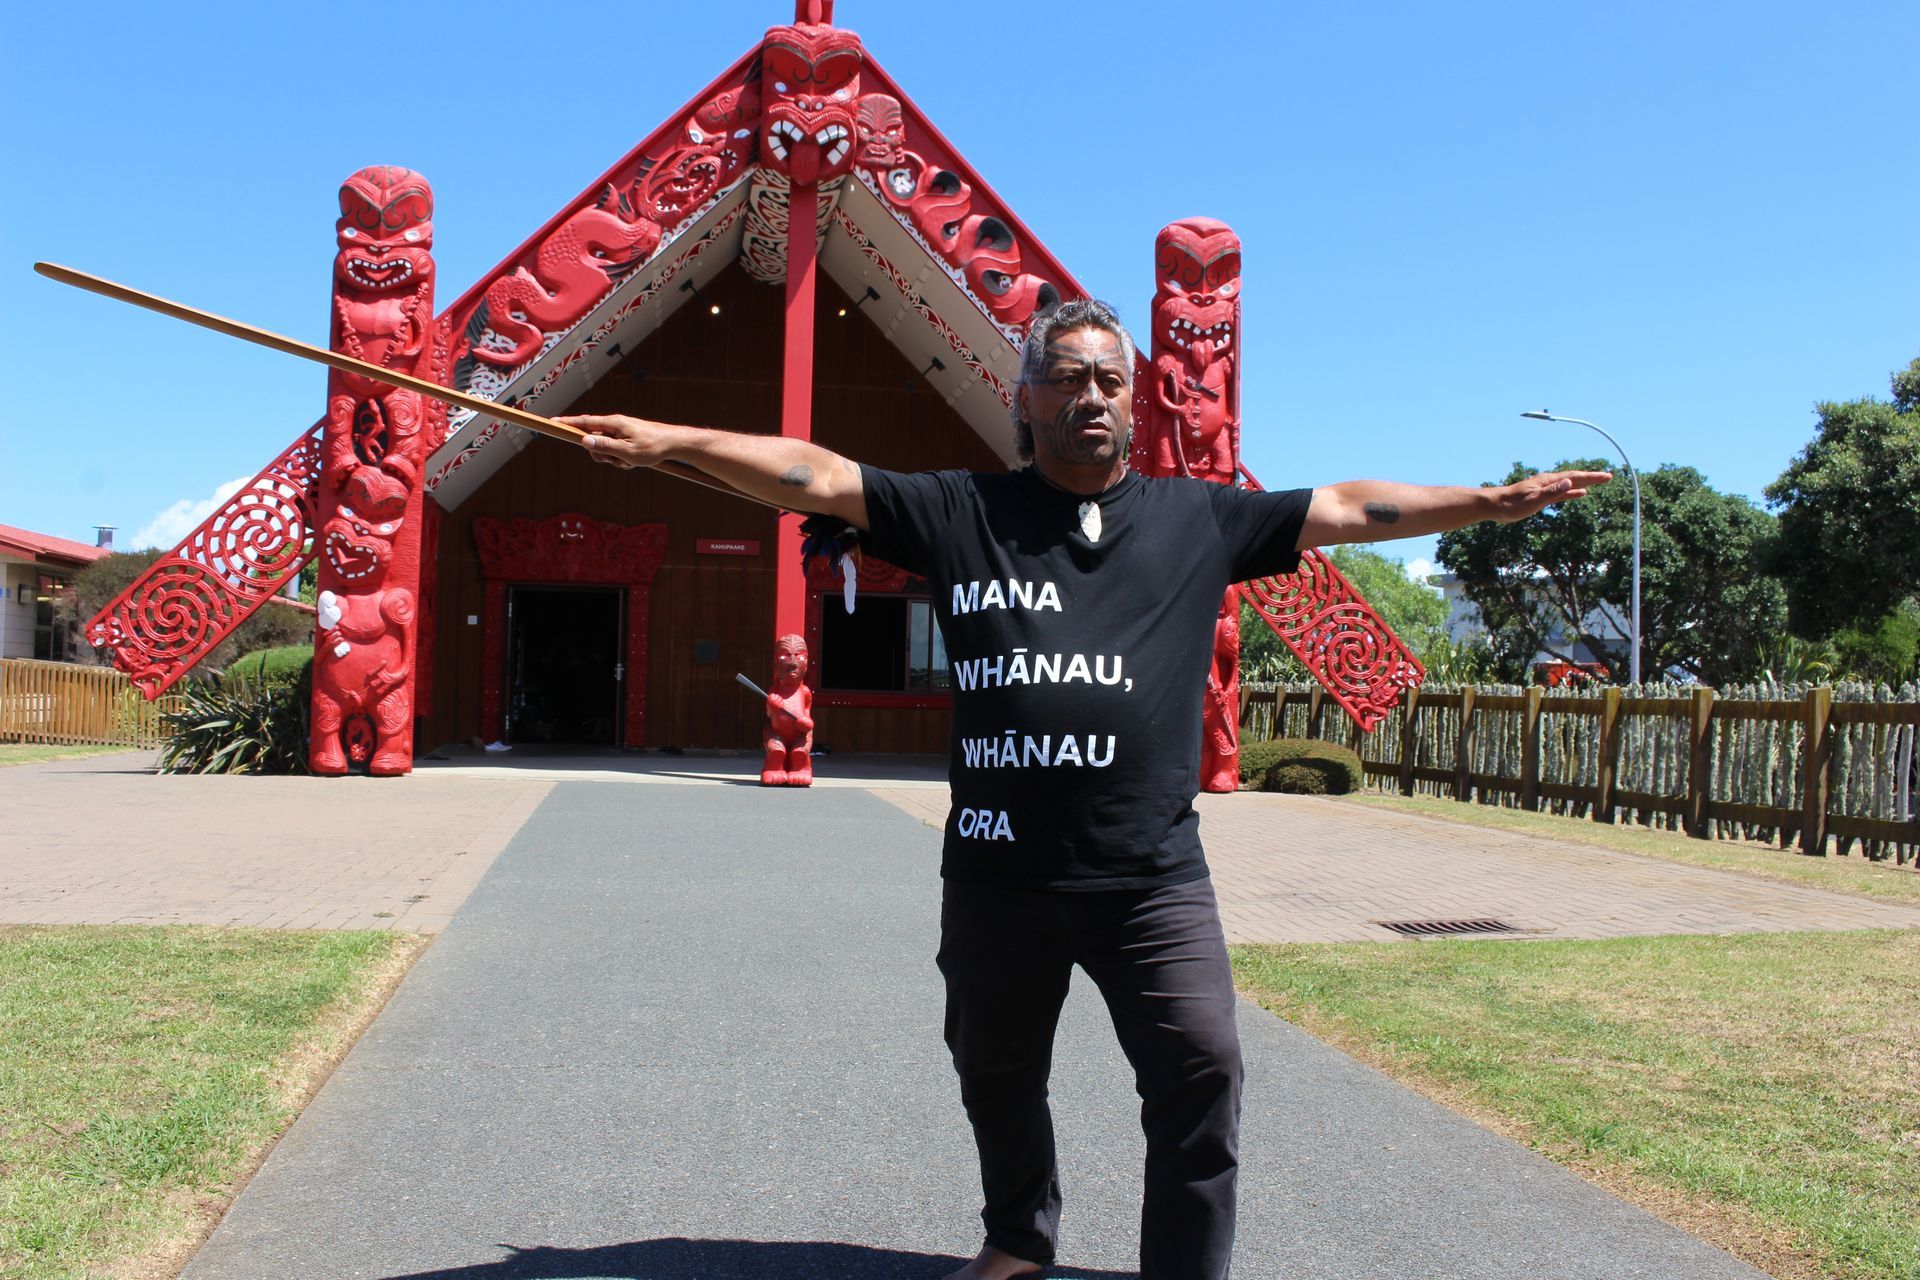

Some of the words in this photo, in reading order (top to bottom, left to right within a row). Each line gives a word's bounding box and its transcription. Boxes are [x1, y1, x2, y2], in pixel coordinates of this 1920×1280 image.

[952, 577, 1063, 616] MANA
[953, 647, 1134, 692] WHĀNAU,
[961, 729, 1116, 769] WHĀNAU
[957, 807, 1016, 842] ORA
